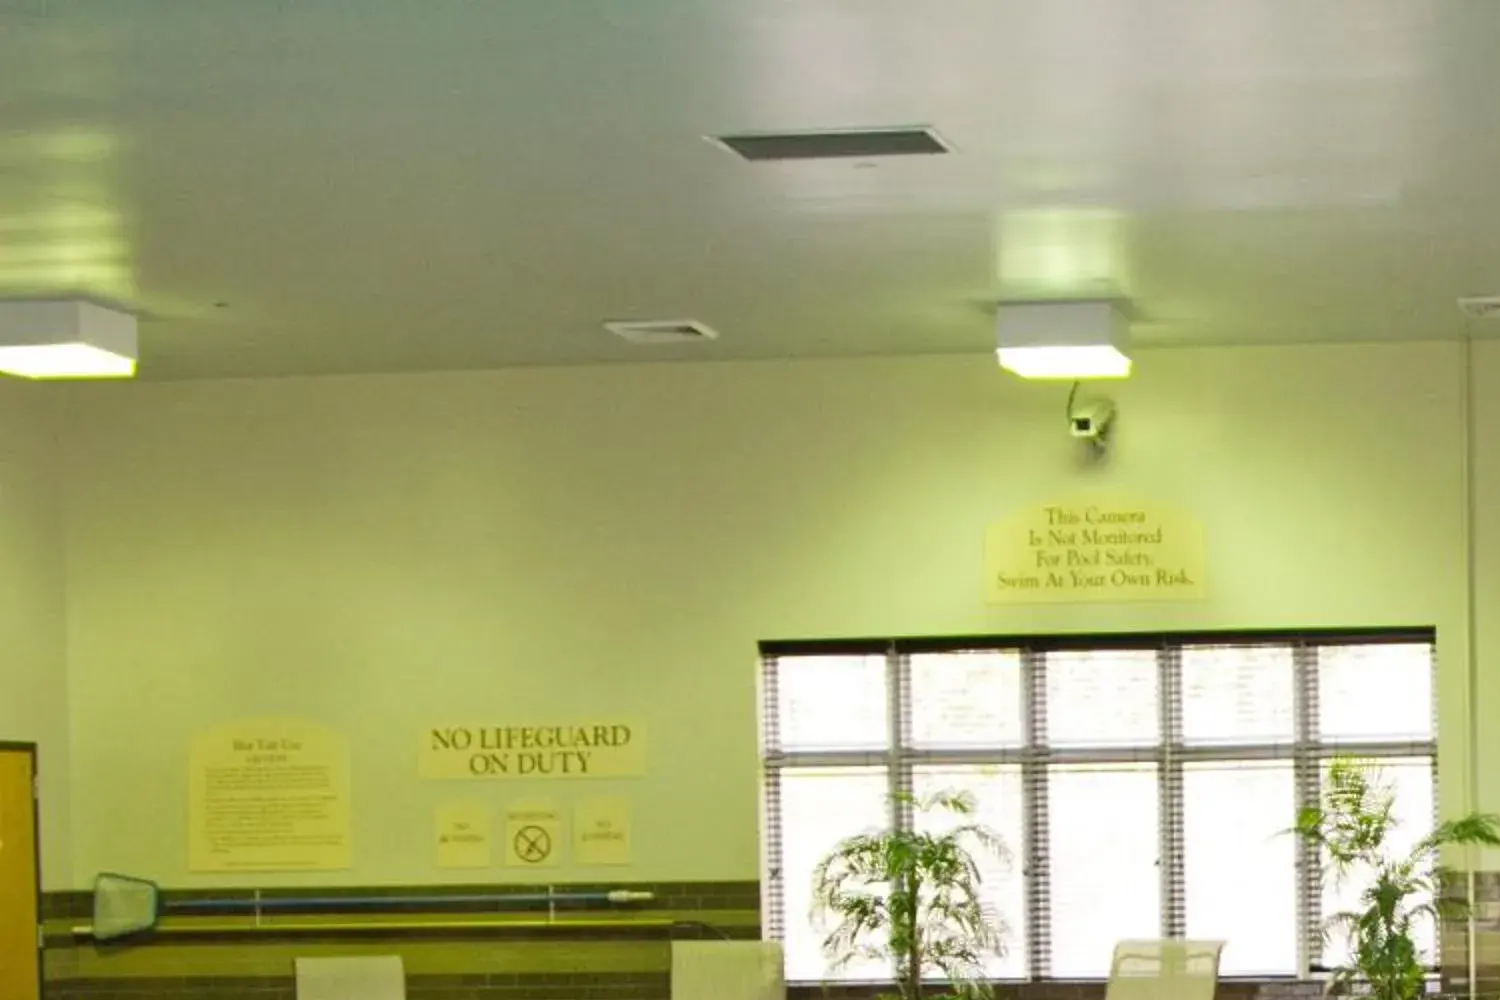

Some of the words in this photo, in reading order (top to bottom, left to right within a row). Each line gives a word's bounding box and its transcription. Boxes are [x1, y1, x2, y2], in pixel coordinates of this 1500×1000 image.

[1045, 506, 1080, 525] This
[1085, 506, 1146, 525] Camera
[1028, 529, 1043, 547] Is
[1048, 529, 1076, 547] Not
[1081, 527, 1162, 546] Monitored
[1035, 550, 1061, 567] For
[1066, 550, 1100, 567] Pool
[997, 572, 1040, 589] Swim
[1045, 571, 1065, 588] At
[1068, 570, 1106, 589] Your
[1110, 569, 1151, 588] Own
[431, 727, 472, 750] NO
[479, 724, 632, 750] LIFEGUARD
[469, 752, 508, 776] ON
[517, 750, 592, 775] DUTY
